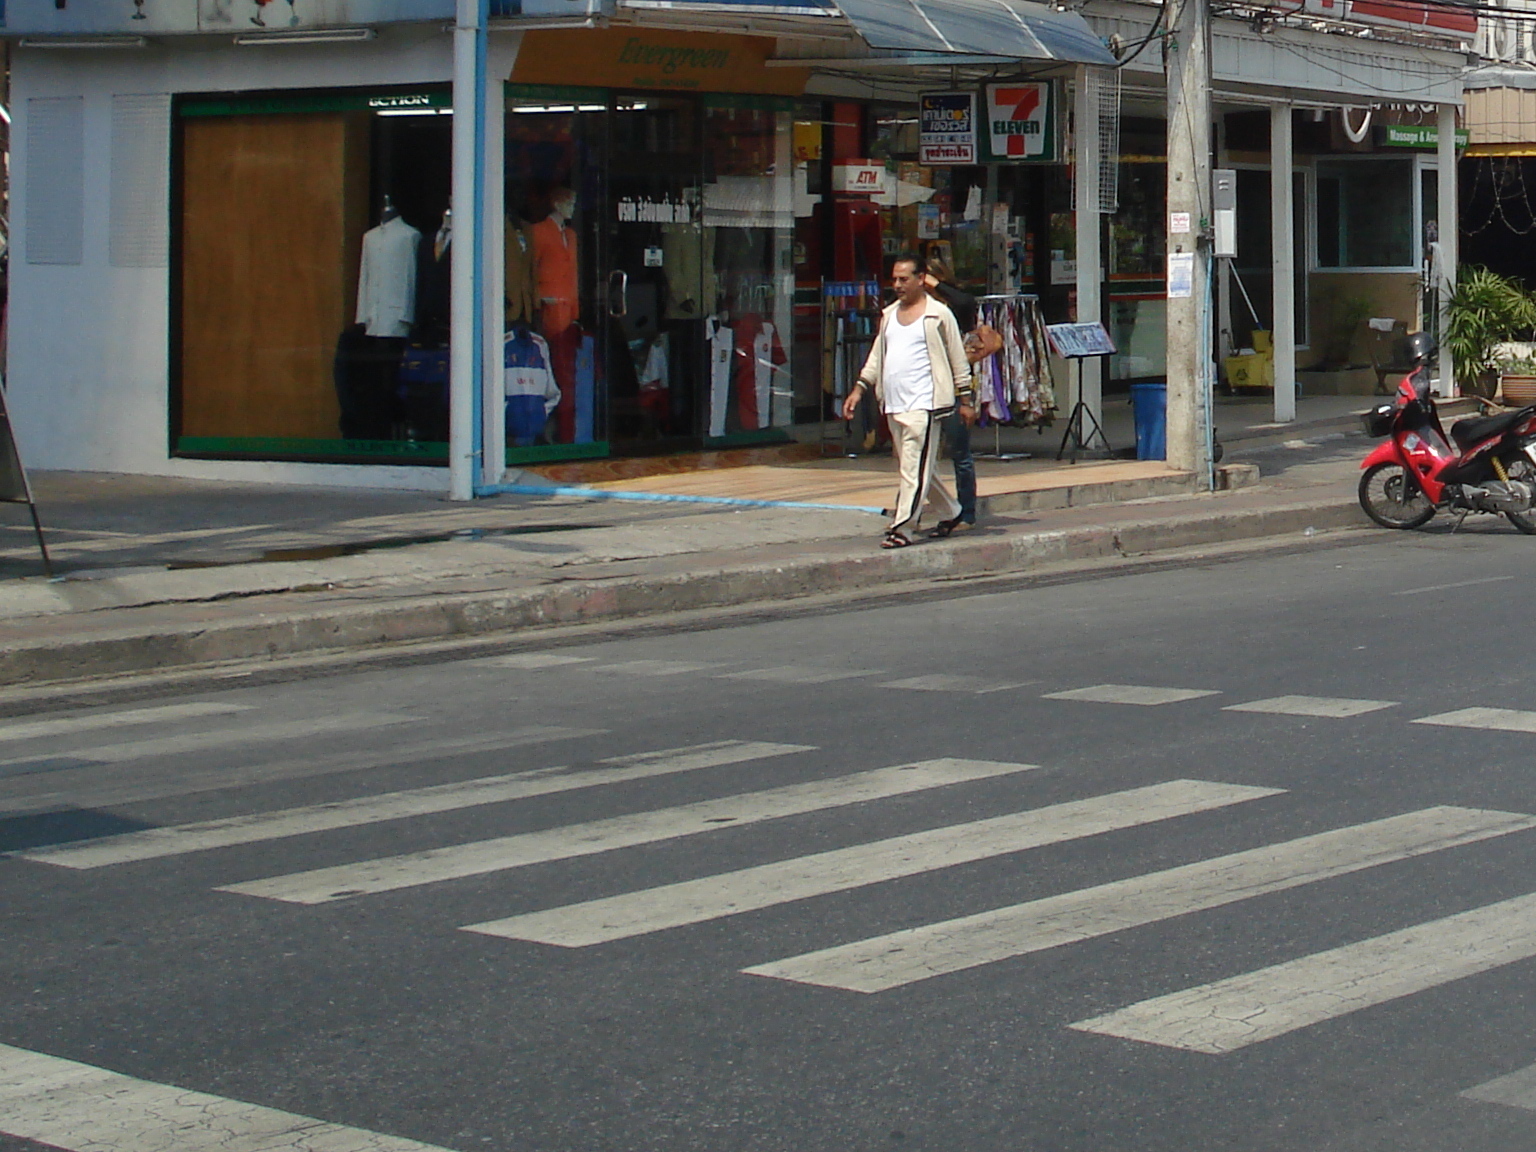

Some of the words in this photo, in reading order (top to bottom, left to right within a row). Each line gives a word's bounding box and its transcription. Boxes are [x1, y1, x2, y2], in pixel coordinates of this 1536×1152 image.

[618, 37, 729, 74] Evergreen
[995, 88, 1040, 156] 7
[1389, 129, 1419, 145] Massage
[856, 171, 878, 184] ATM
